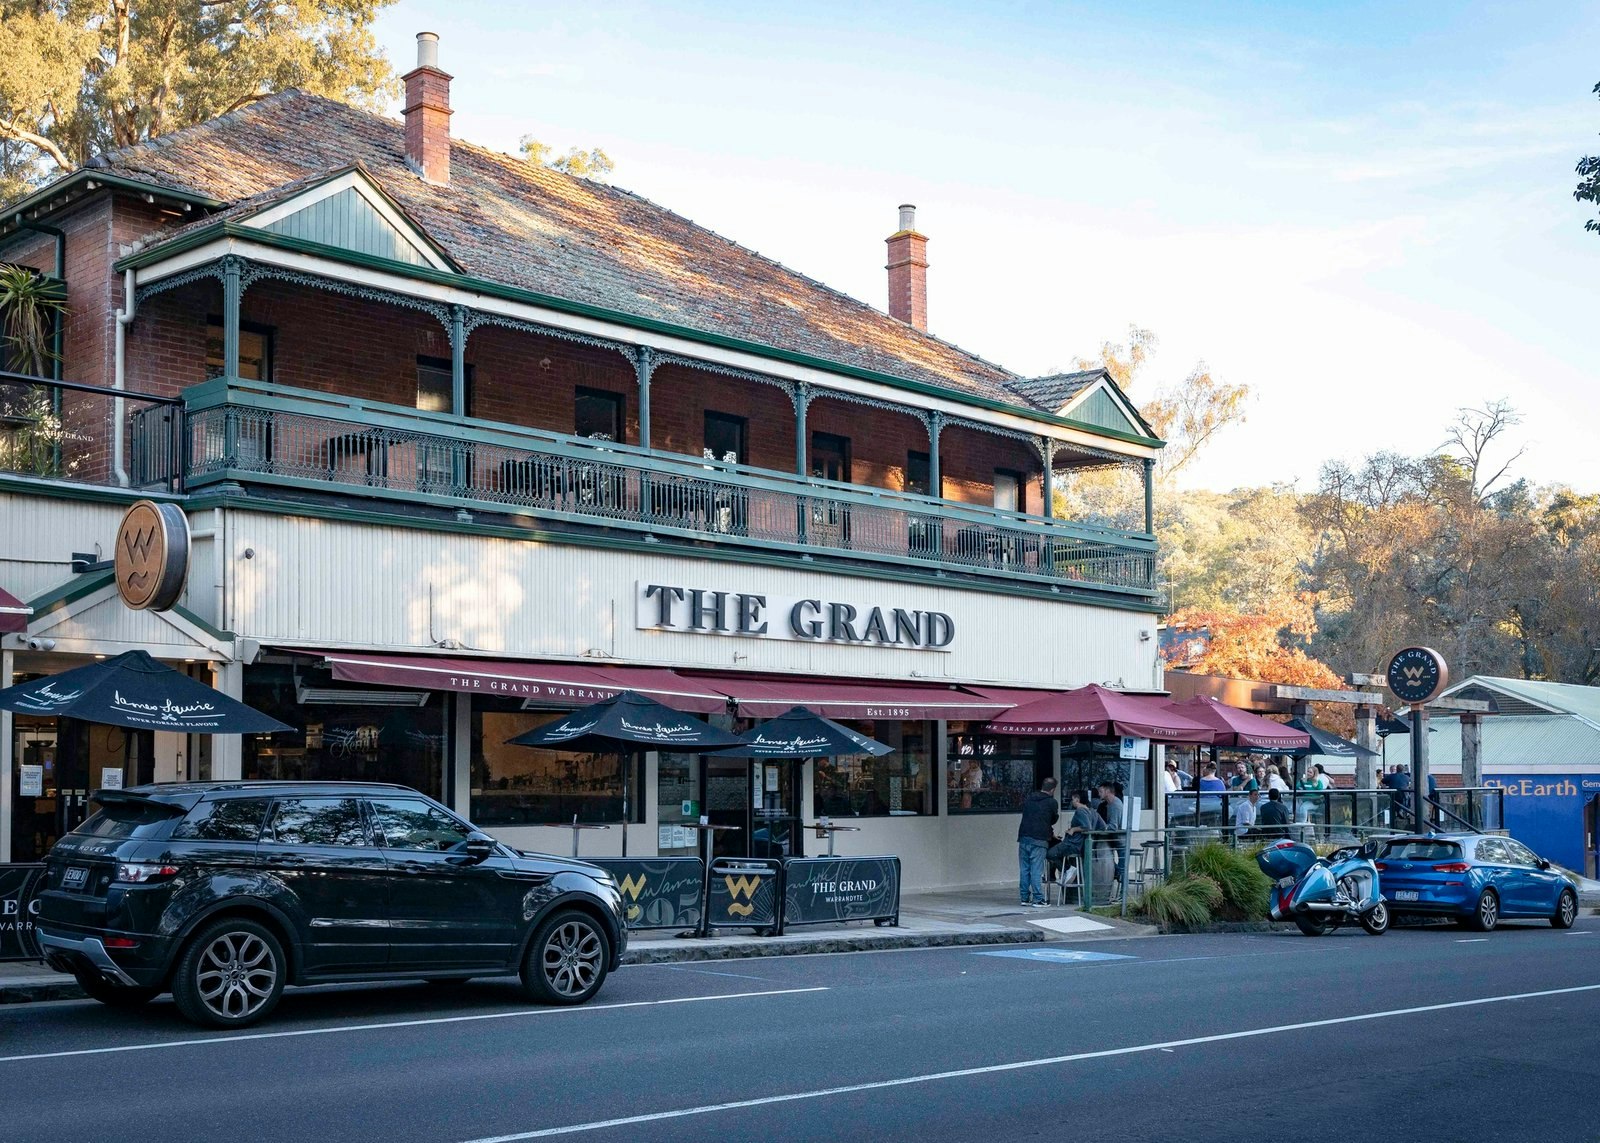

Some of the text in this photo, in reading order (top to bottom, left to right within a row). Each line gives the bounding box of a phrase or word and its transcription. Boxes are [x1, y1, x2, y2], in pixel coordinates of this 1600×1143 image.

[646, 584, 955, 648] THE GRAND
[1390, 651, 1437, 676] THE GRAND
[1403, 666, 1424, 679] W
[450, 677, 617, 700] THE GRAND WARRAND
[114, 689, 158, 710] James
[866, 707, 910, 717] Est. 1895
[126, 716, 150, 724] NEVER
[151, 719, 185, 727] FORSAKE
[725, 874, 761, 900] W
[812, 881, 836, 894] THE
[839, 879, 876, 893] GRAND
[825, 894, 863, 903] WARRANDYTE
[0, 921, 37, 931] ARR
